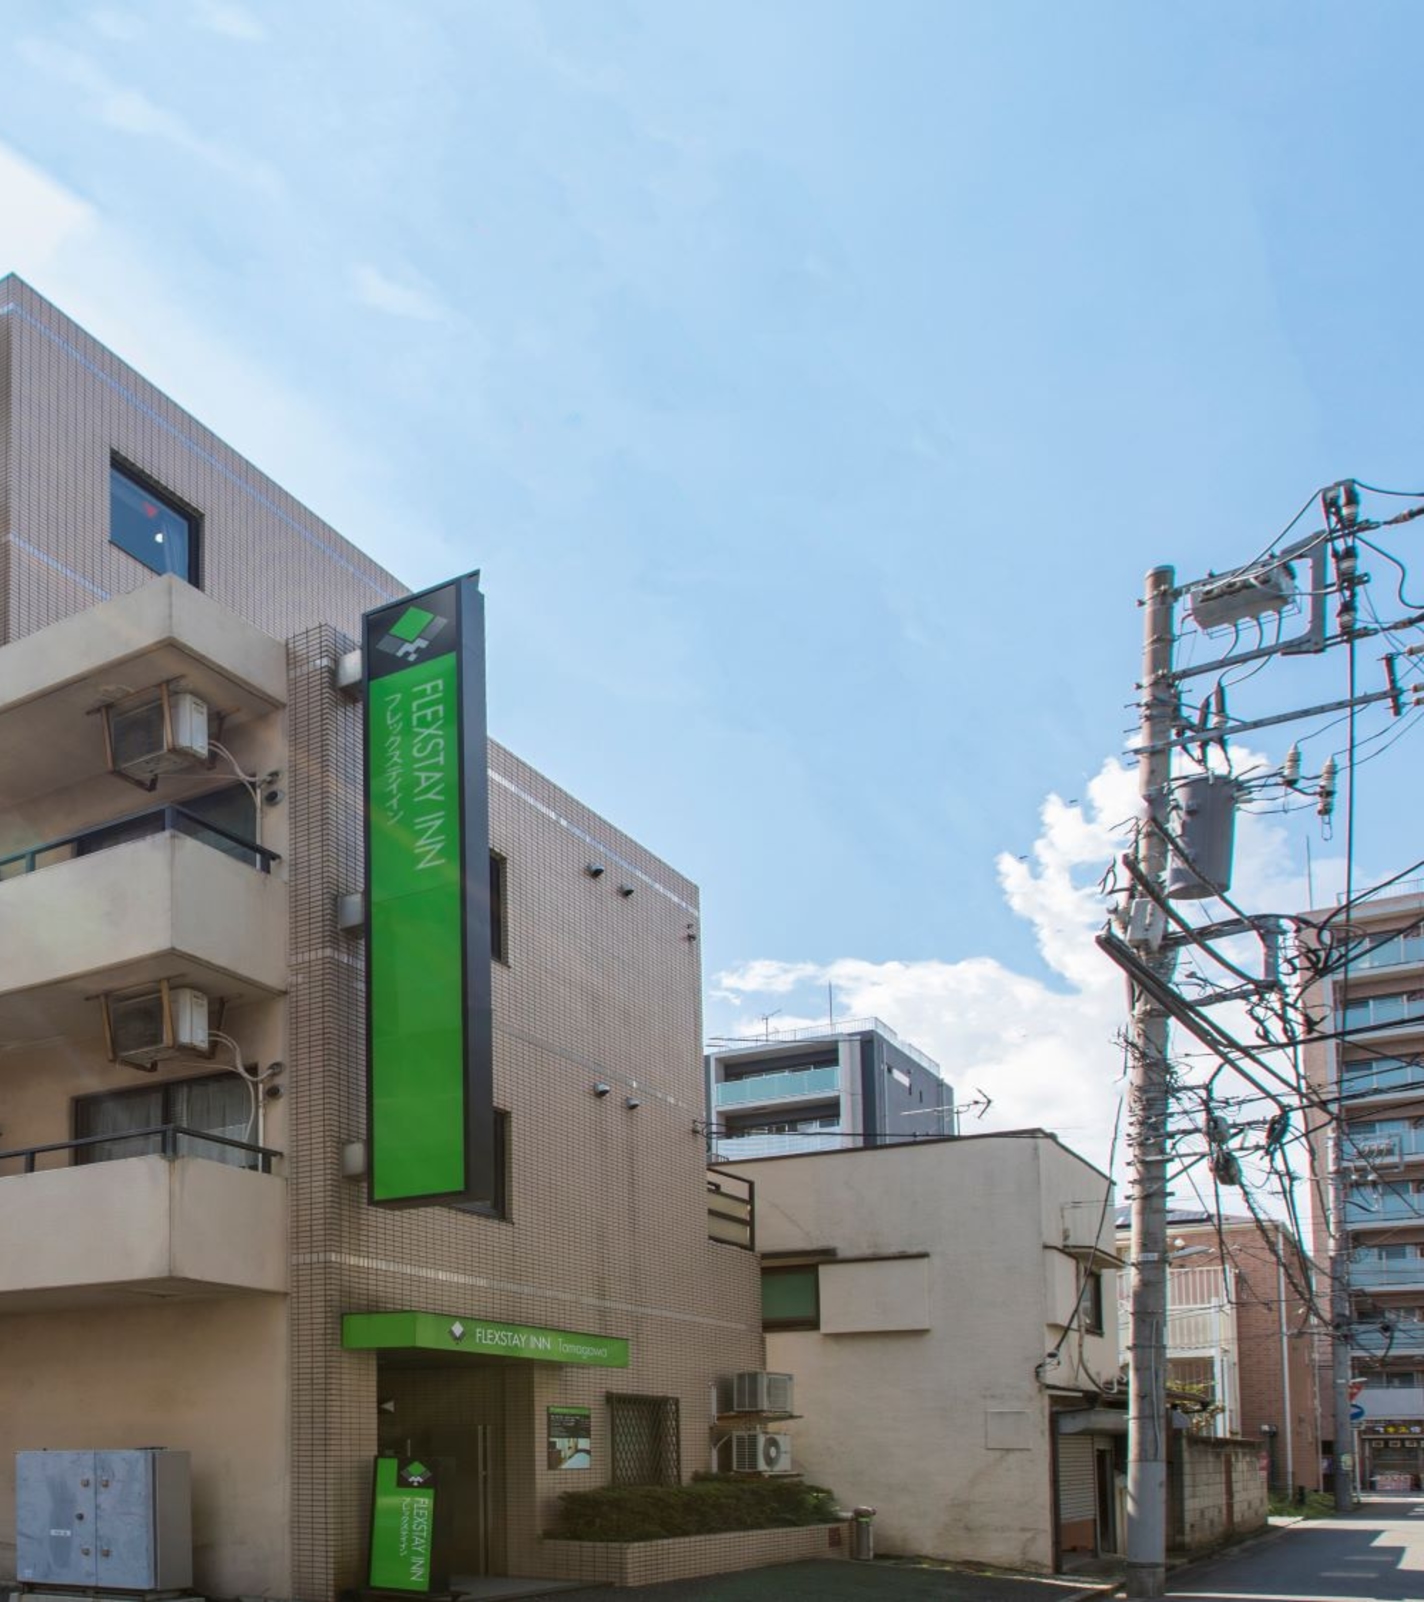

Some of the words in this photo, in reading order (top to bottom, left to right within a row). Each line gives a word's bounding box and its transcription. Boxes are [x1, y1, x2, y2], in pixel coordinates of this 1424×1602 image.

[412, 678, 445, 801] FLEXSTAY
[414, 811, 445, 870] INN
[475, 1327, 527, 1349] FLEXSTAY
[529, 1334, 551, 1351] INN
[558, 1338, 608, 1359] Tamagawa
[411, 1497, 429, 1554] FLEXSTAY
[409, 1555, 425, 1582] INN
